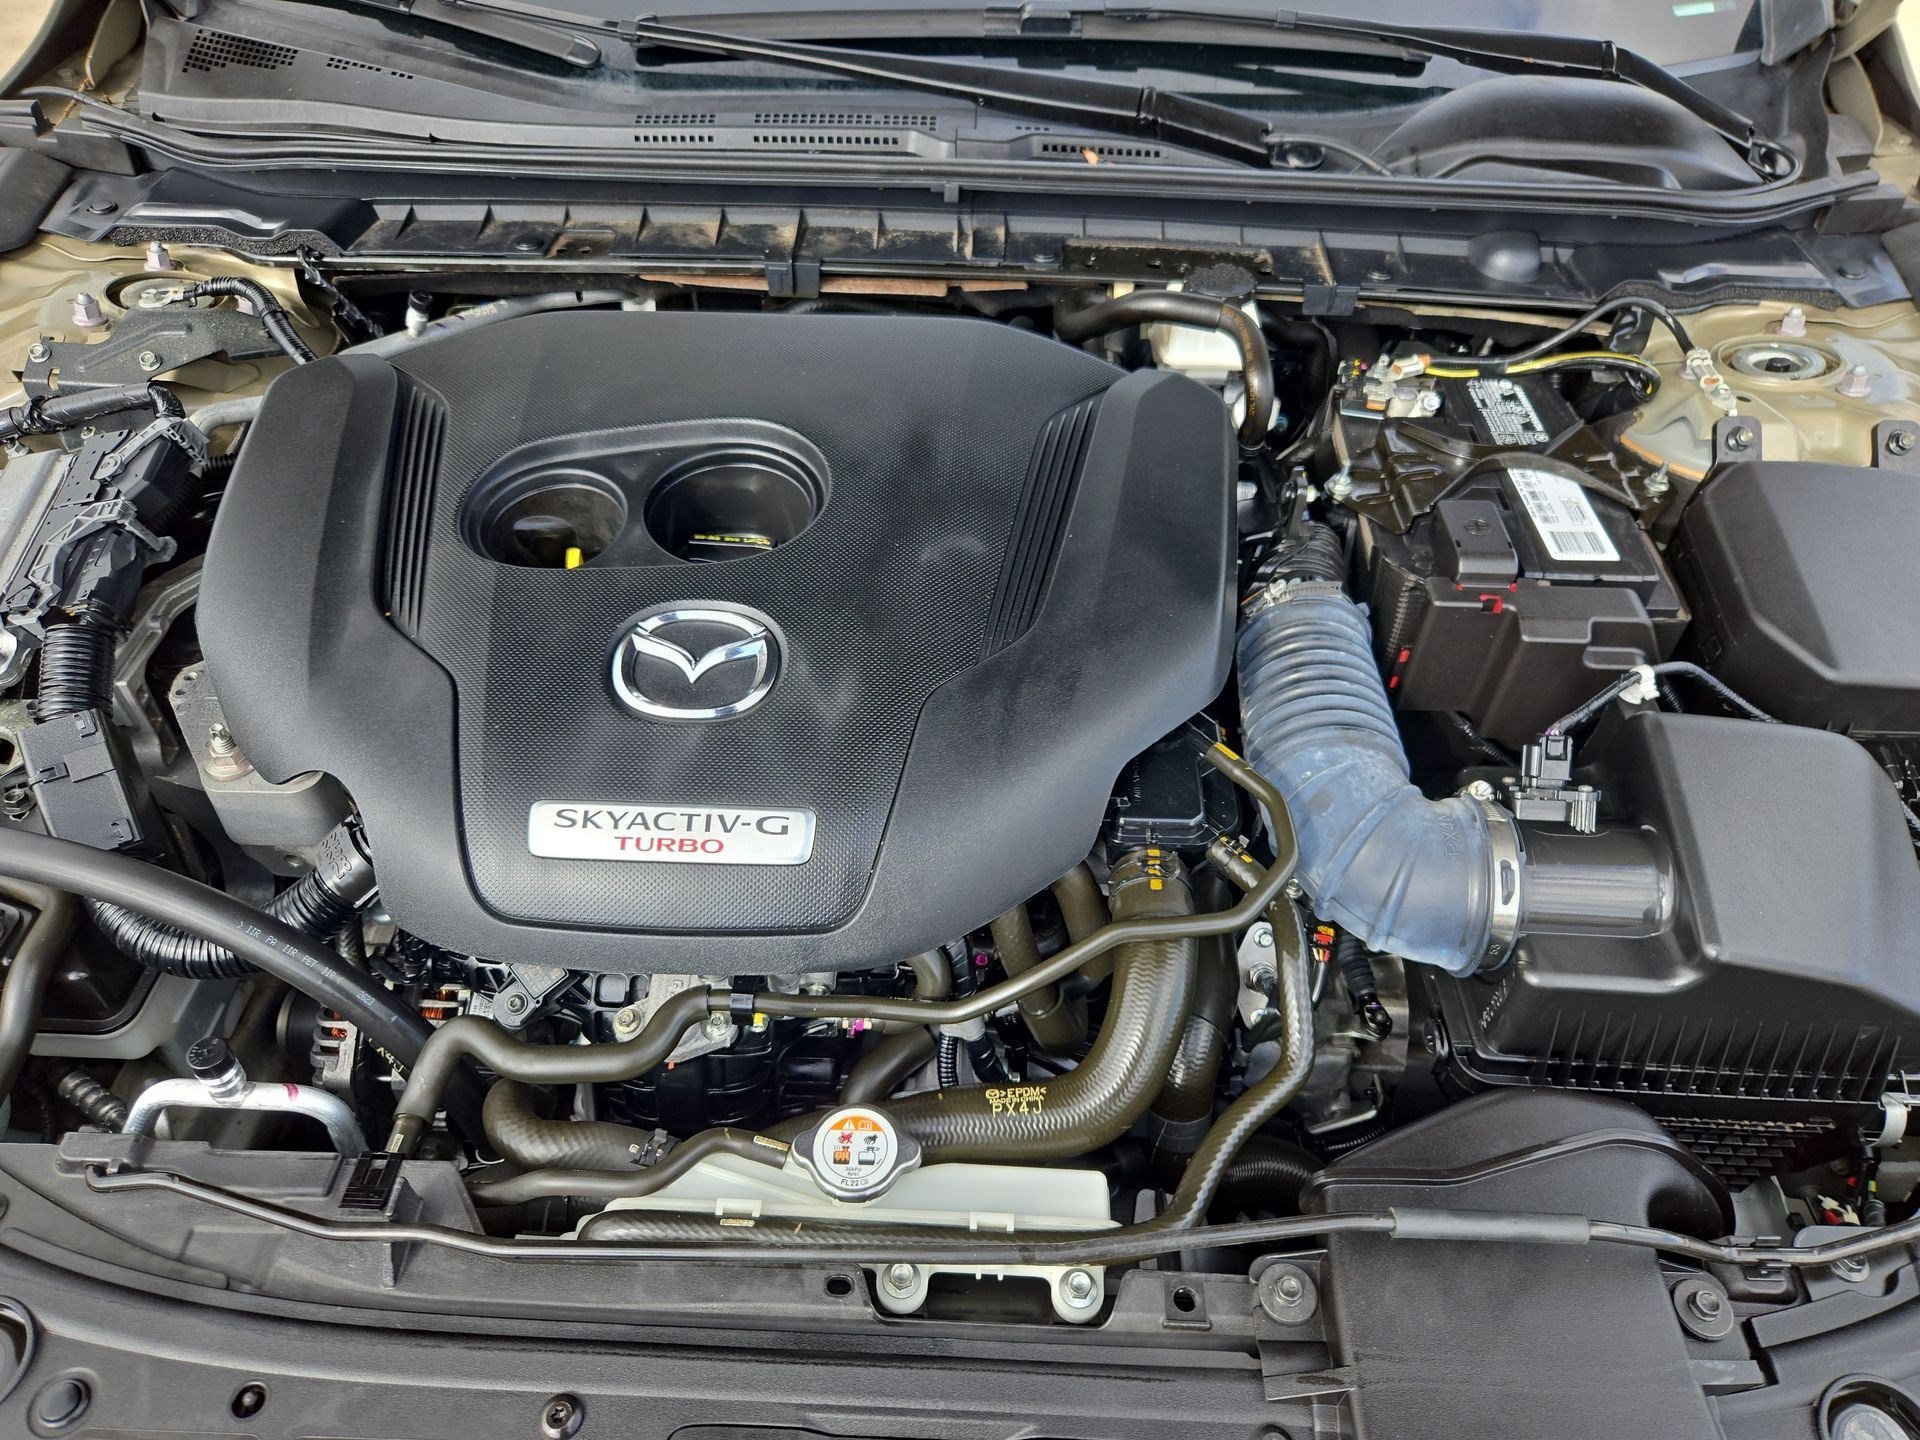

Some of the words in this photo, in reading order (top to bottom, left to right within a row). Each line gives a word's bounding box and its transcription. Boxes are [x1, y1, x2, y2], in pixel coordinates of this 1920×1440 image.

[553, 808, 790, 836] SKYACTIV-G
[614, 836, 724, 854] TURBO
[301, 955, 318, 968] PET
